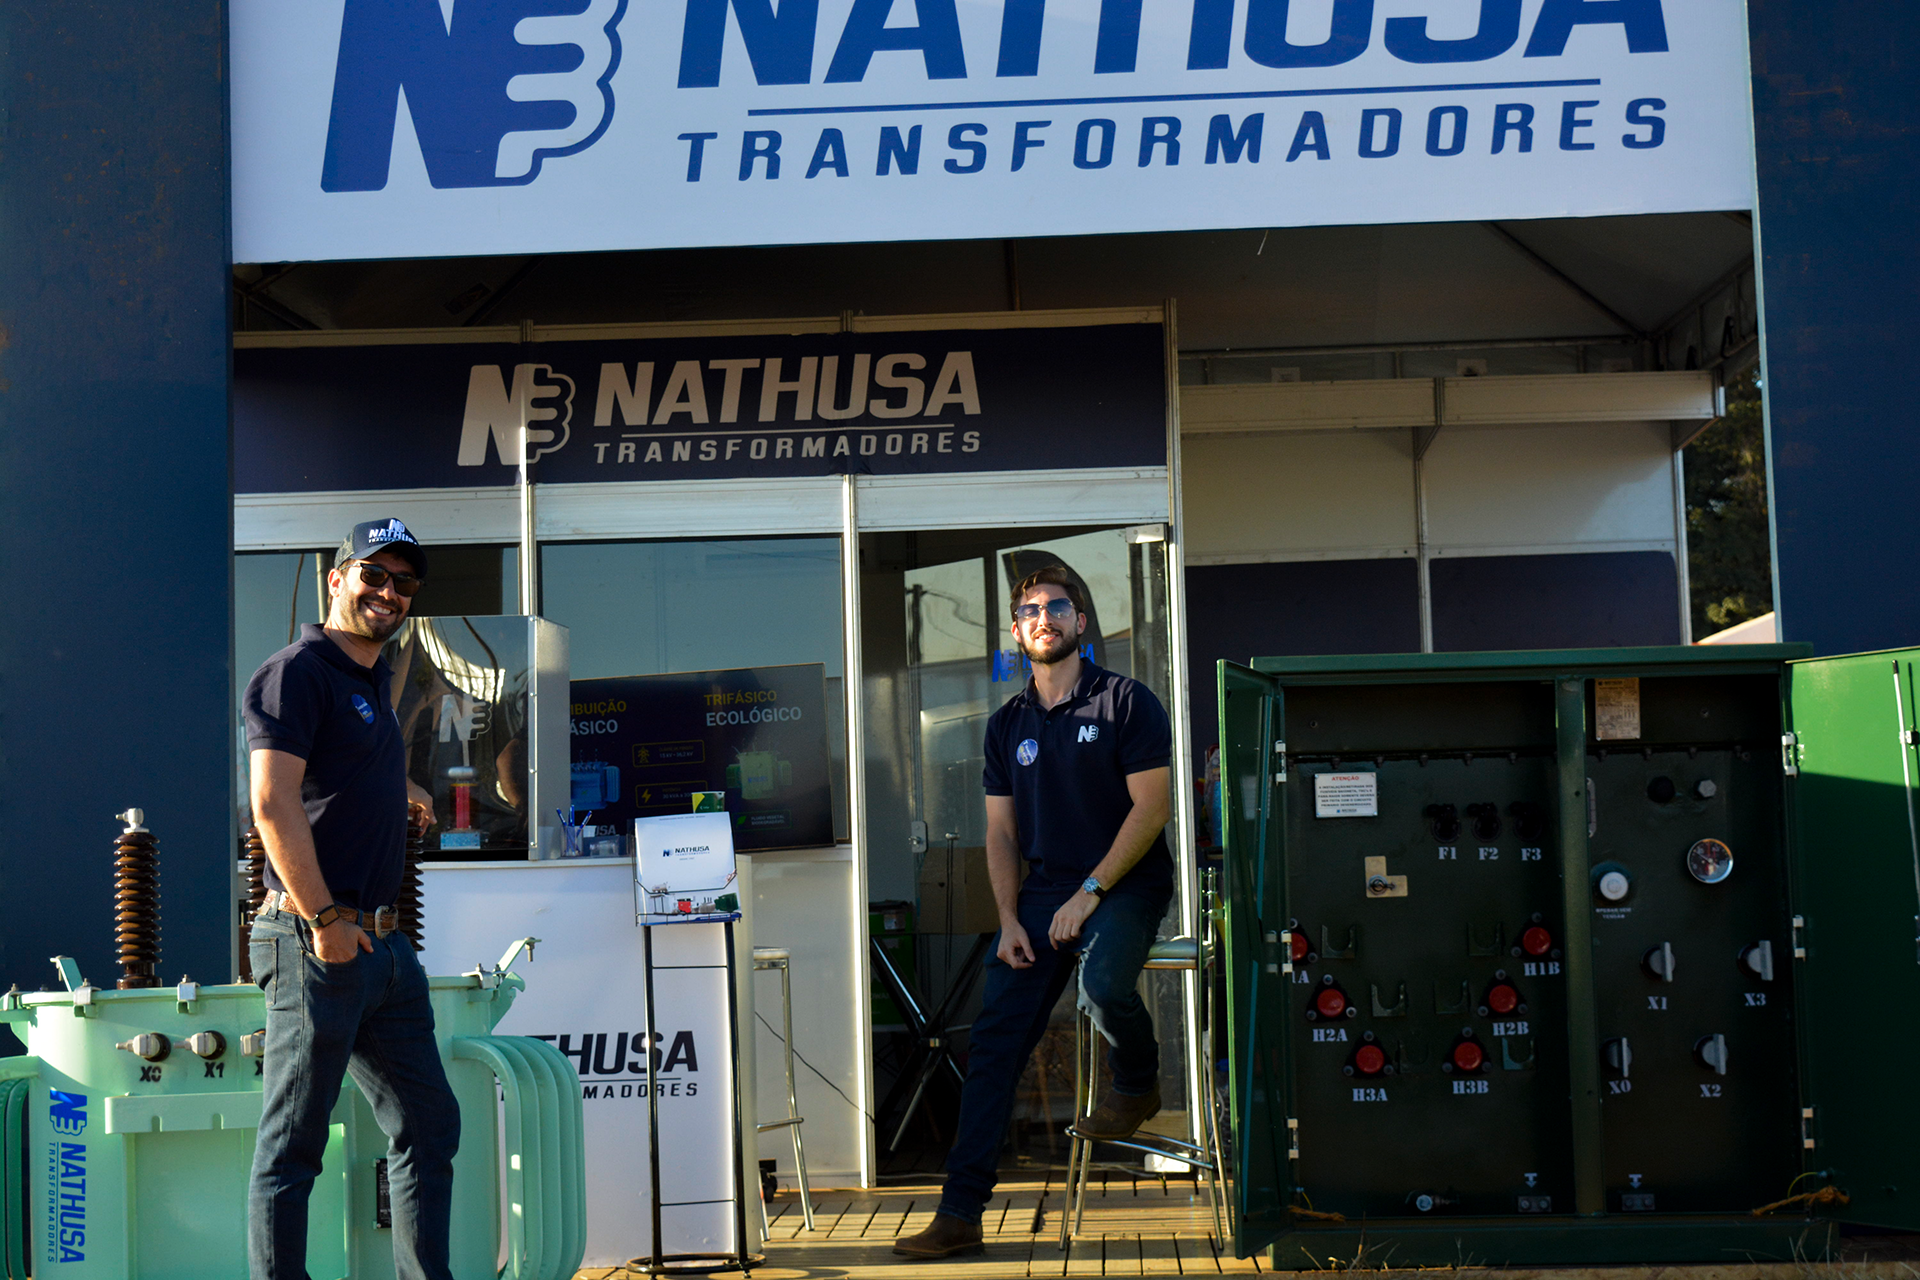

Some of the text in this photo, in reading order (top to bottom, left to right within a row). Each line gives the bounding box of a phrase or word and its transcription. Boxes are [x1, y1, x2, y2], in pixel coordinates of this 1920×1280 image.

[677, 98, 1666, 182] TRANSFORMADORES
[594, 351, 982, 426] NATHUSA
[594, 430, 981, 464] TRANSFORMADORES
[704, 690, 777, 706] TRIFÁSICO
[706, 706, 802, 726] ECOLÓGICO
[675, 845, 710, 853] NATHUSA
[1438, 847, 1457, 860] F1
[1478, 847, 1499, 860] F2
[1521, 848, 1542, 861] F3
[1523, 961, 1560, 977] H1B
[1648, 996, 1668, 1010] X1
[1743, 992, 1767, 1006] X3
[1312, 1028, 1348, 1042] H2A
[1492, 1021, 1529, 1037] H2B
[139, 1066, 162, 1083] X0
[204, 1062, 225, 1078] X1
[1352, 1088, 1388, 1102] H3A
[1452, 1080, 1489, 1095] H3B
[1608, 1079, 1632, 1095] X0
[1700, 1084, 1722, 1098] X2
[47, 1142, 56, 1263] TRANSFORMADORES
[59, 1142, 87, 1264] NATHUSA
